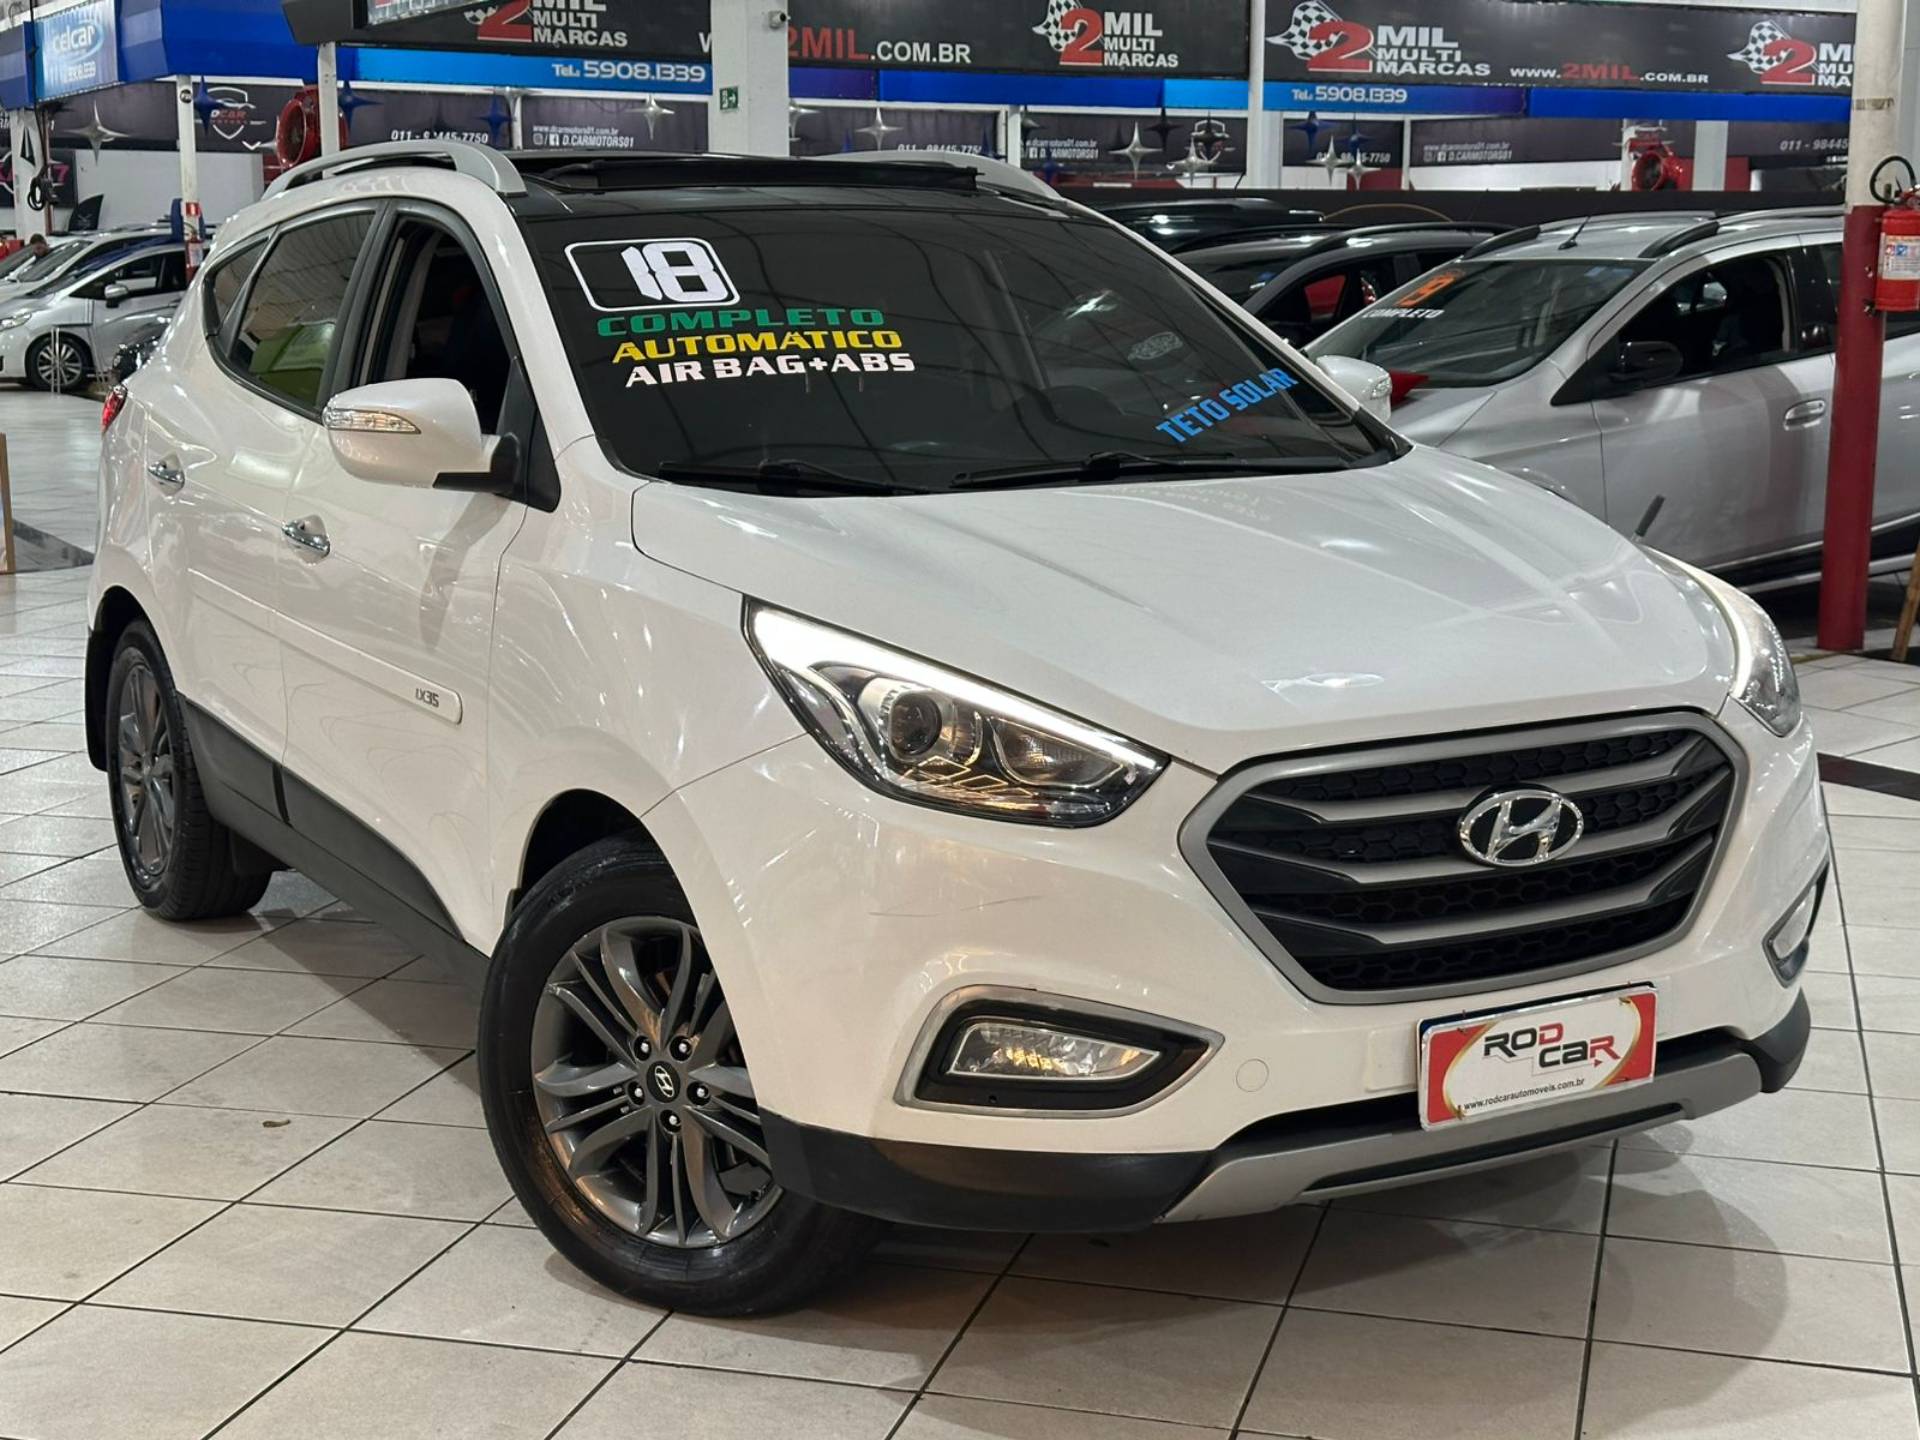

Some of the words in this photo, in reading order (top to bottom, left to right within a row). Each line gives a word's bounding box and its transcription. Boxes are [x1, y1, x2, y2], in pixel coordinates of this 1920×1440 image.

[533, 11, 597, 28] MULTI
[1103, 12, 1163, 37] MIL
[533, 28, 628, 47] MARCAS
[1103, 37, 1156, 52] MULTI
[1377, 25, 1459, 48] MIL
[1103, 52, 1179, 68] MARCAS
[1377, 47, 1461, 62] MULTI
[584, 61, 706, 82] 5908.1339
[1377, 61, 1491, 76] MARCAS
[1315, 86, 1408, 103] 5908.1339
[391, 129, 412, 141] 011
[1780, 140, 1802, 151] 011
[621, 242, 729, 302] 18
[597, 308, 885, 337] COMPLETO
[625, 361, 705, 388] AIR
[714, 353, 916, 379] BAG+ABS
[1155, 398, 1231, 443] TETO
[1219, 367, 1299, 411] SOLAR
[1463, 1077, 1586, 1111] www.rodcarautomoveis.com.br
